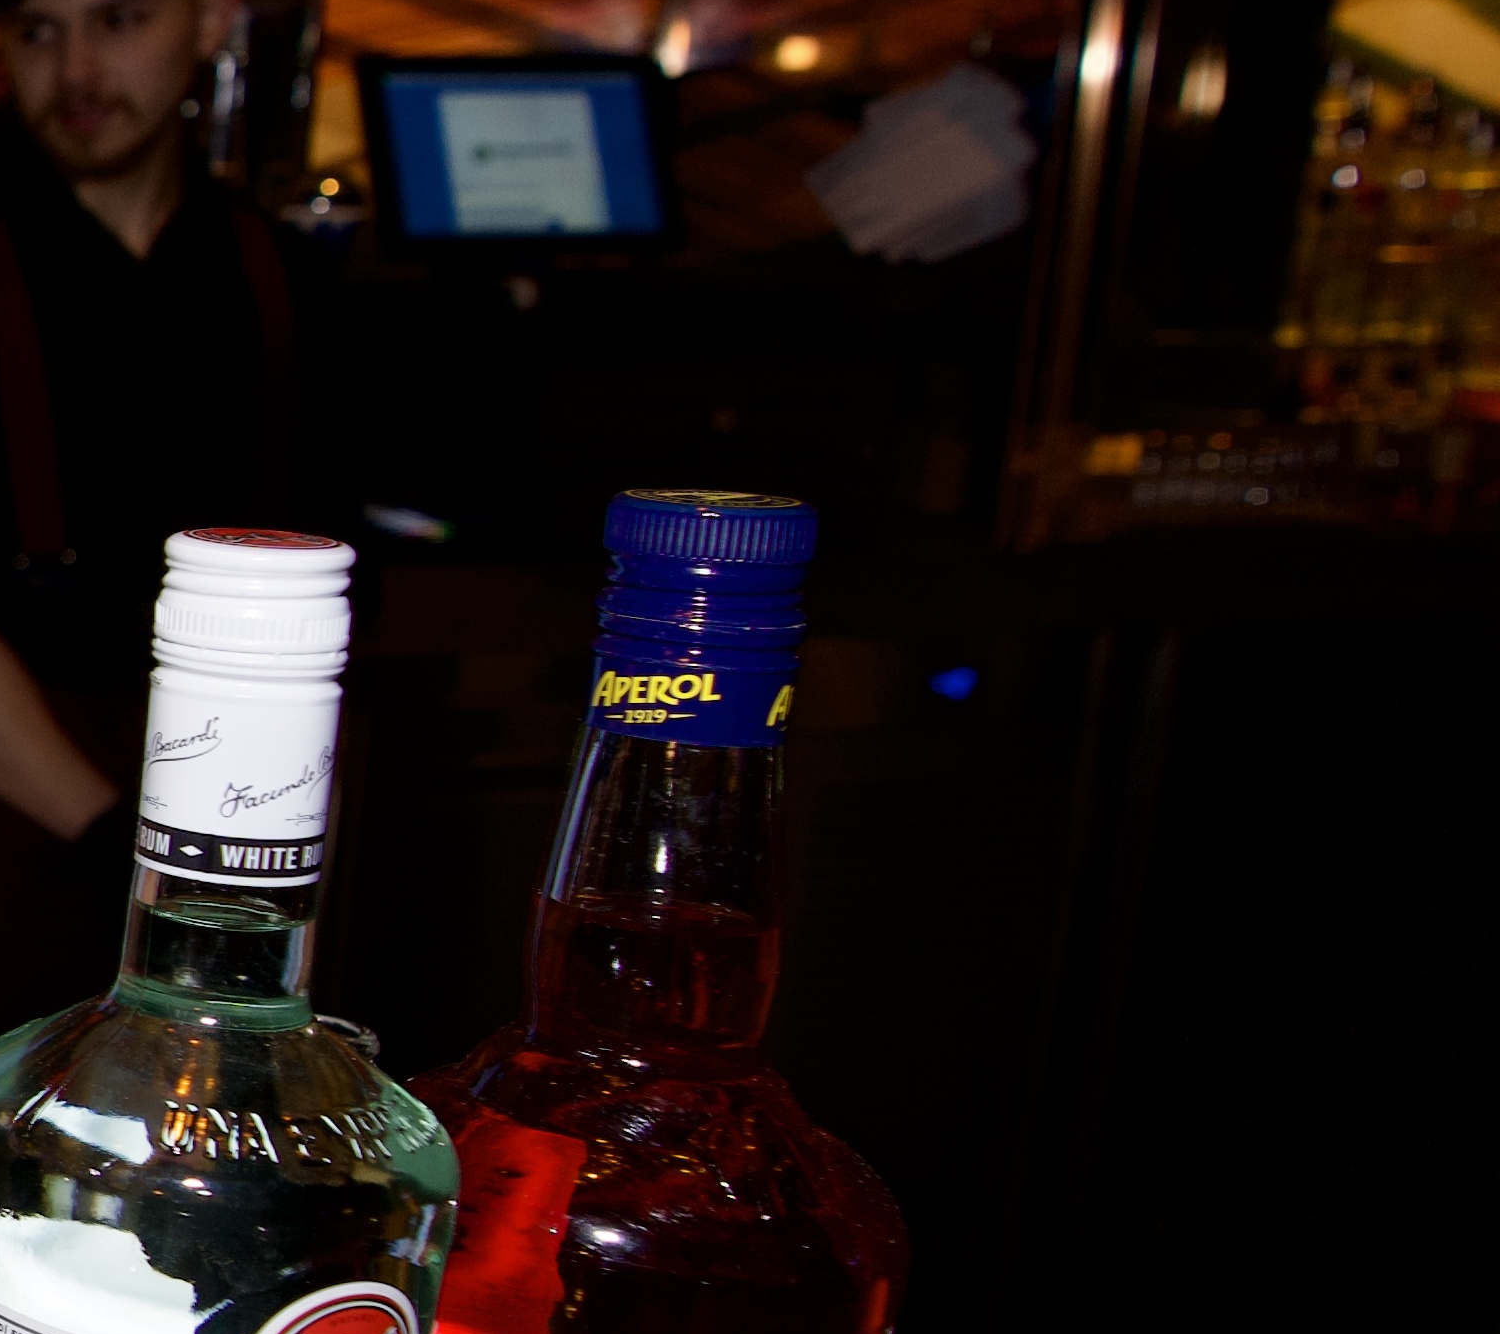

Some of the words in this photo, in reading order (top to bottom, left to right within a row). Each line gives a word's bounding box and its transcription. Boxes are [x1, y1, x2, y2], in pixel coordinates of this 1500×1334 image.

[592, 670, 722, 707] APEROL
[623, 710, 668, 724] 1919
[139, 824, 171, 857] RUM
[220, 843, 298, 870] WHITE
